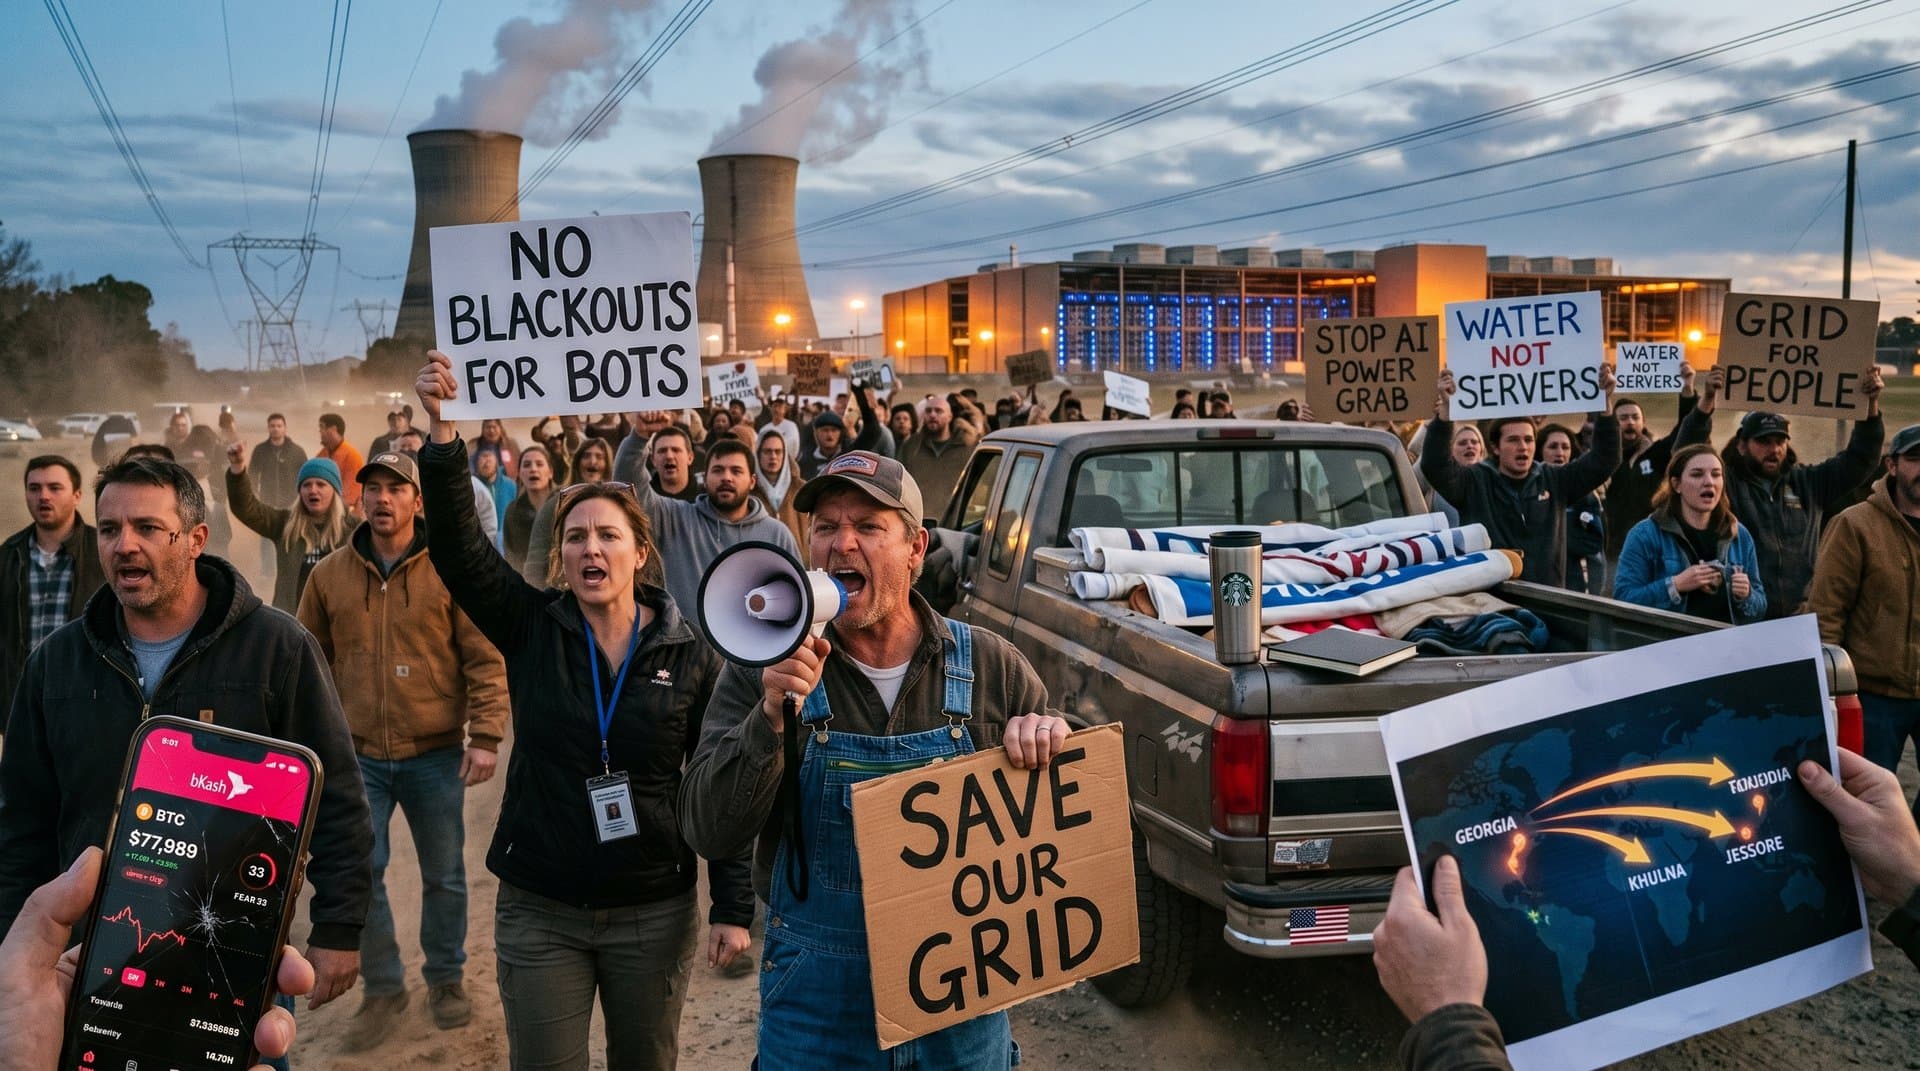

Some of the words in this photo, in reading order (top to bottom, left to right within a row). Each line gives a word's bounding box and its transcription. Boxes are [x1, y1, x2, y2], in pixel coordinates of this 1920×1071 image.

[510, 225, 592, 281] NO
[449, 280, 692, 345] BLACKOUTS
[1456, 301, 1581, 341] WATER
[1735, 300, 1849, 341] GRID
[1316, 323, 1387, 354] STOP
[1394, 322, 1430, 353] AI
[1622, 345, 1679, 360] WATER
[1491, 341, 1552, 368] NOT
[1633, 362, 1660, 373] NOT
[1768, 343, 1819, 367] FOR
[465, 356, 545, 404] FOR
[566, 343, 689, 403] BOTS
[1326, 358, 1416, 386] POWER
[1616, 375, 1682, 388] SERVERS
[1724, 364, 1860, 409] PEOPLE
[1336, 388, 1409, 414] GRAB
[1458, 368, 1600, 410] SERVERS
[190, 772, 227, 795] bKash
[156, 808, 186, 826] BTC
[900, 747, 1092, 869] SAVE
[128, 829, 198, 859] $77,989
[1454, 815, 1518, 845] GEORGIA
[1725, 835, 1785, 865] JESSORE
[248, 865, 265, 878] 33
[952, 843, 1066, 917] OUR
[1628, 863, 1687, 892] KHULNA
[233, 892, 256, 904] FEAR
[256, 897, 268, 907] 33
[909, 896, 1103, 1014] GRID
